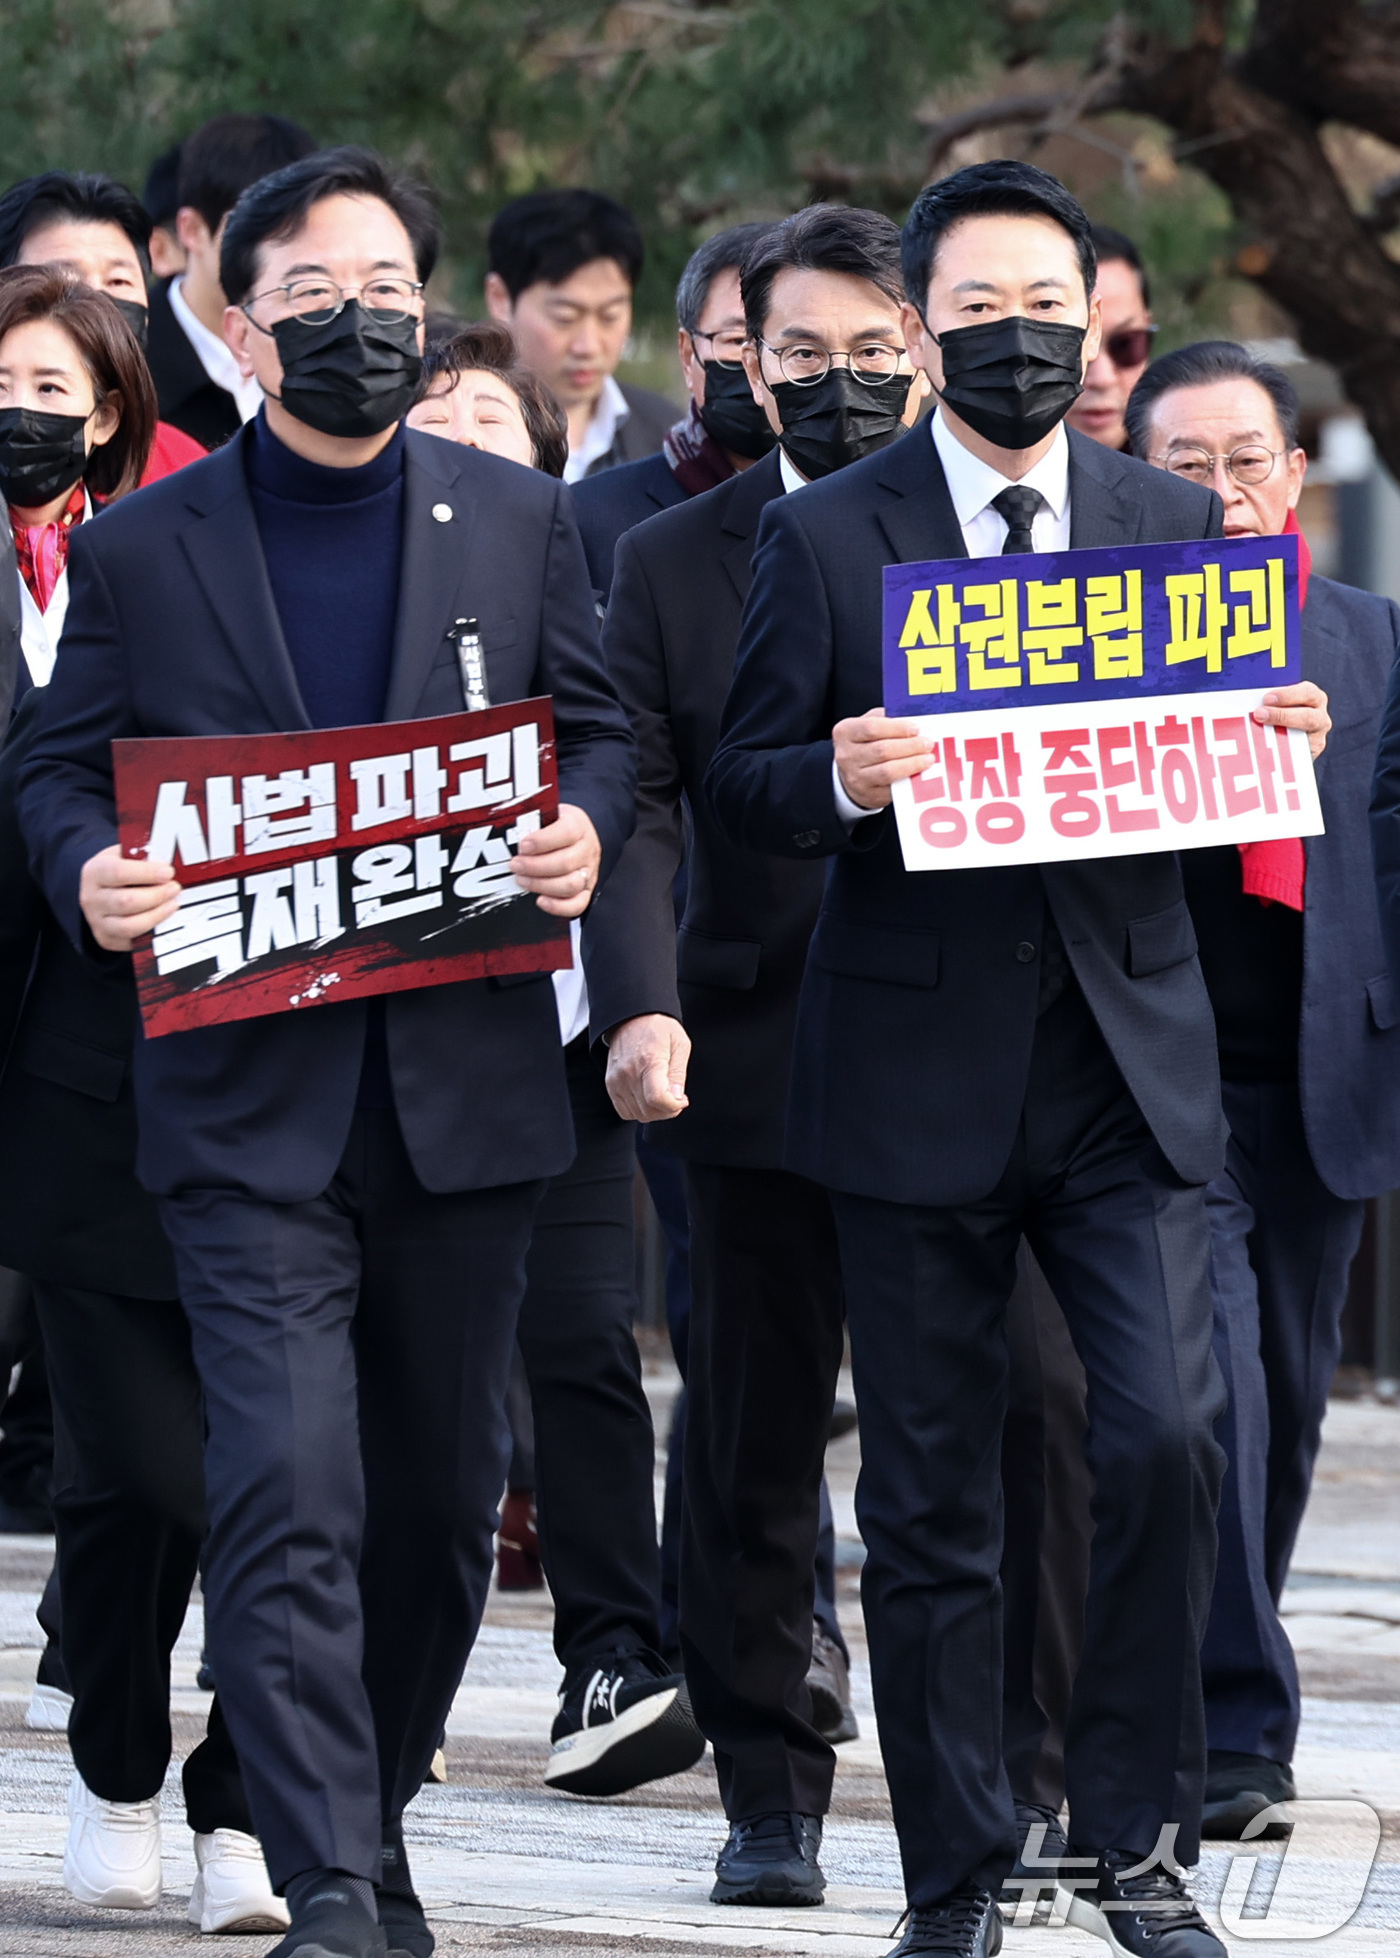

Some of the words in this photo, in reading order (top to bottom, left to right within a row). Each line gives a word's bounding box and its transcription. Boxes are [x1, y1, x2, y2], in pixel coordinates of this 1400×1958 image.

[898, 569, 1143, 696] 삼권분립
[1165, 558, 1286, 673] 파괴
[146, 761, 338, 866] 사법
[350, 722, 541, 831] 파괴
[910, 731, 1026, 849] 당장
[1040, 712, 1301, 838] 중단하라!
[151, 856, 343, 977] 독재
[351, 809, 541, 930] 완성
